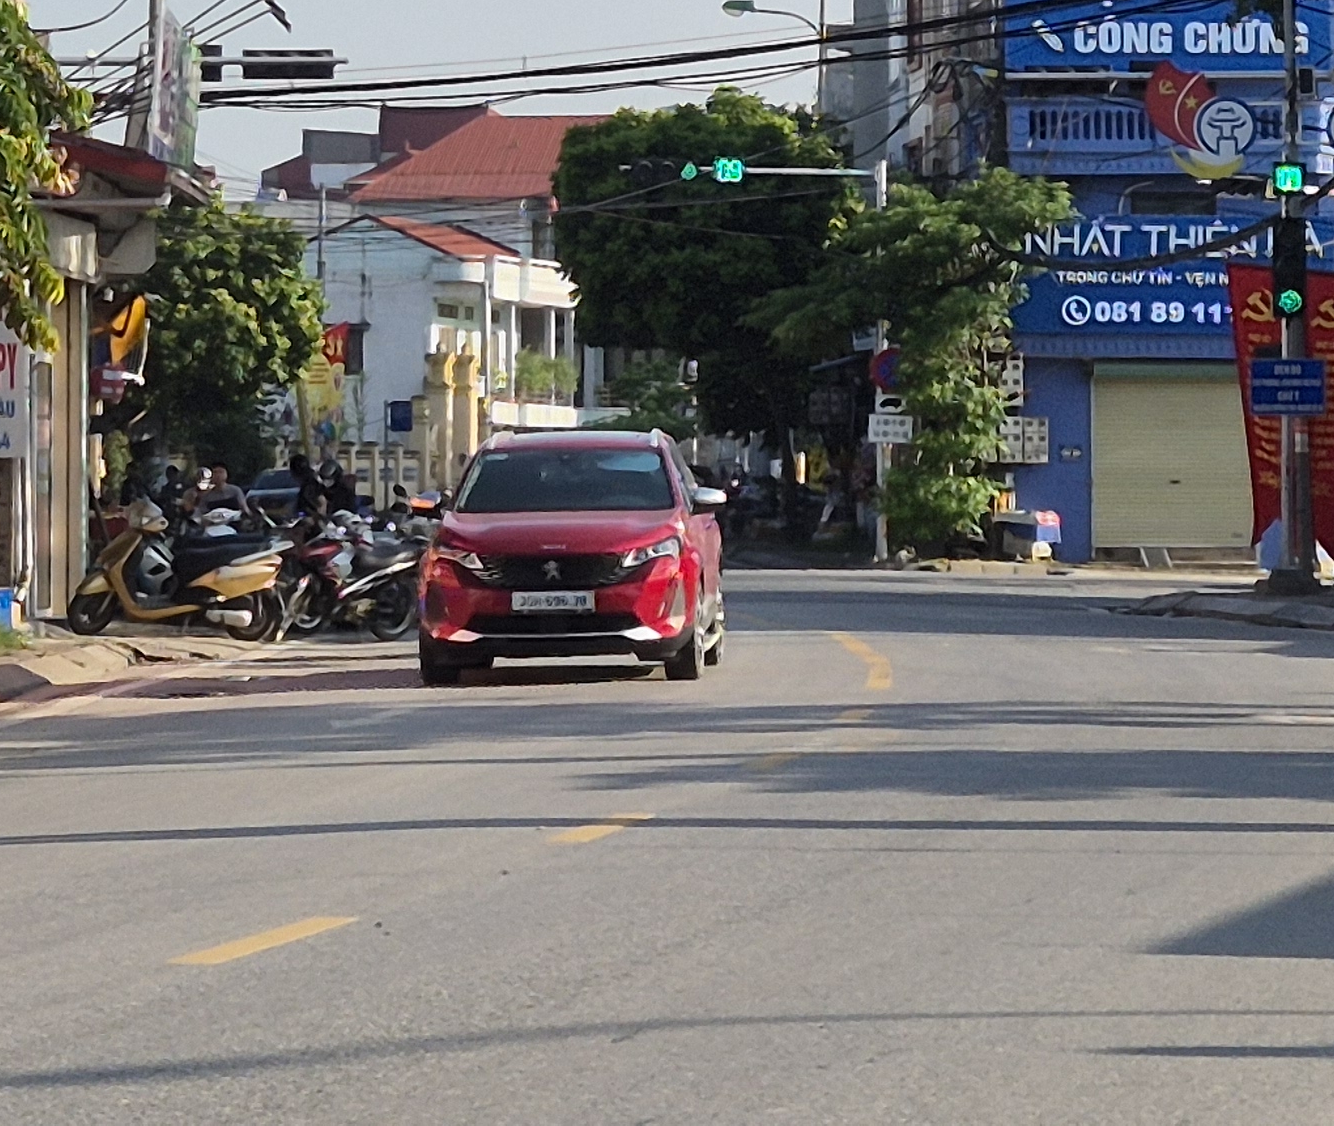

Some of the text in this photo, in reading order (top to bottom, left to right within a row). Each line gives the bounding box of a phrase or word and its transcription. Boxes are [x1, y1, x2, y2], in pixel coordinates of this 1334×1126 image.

[1073, 14, 1173, 54] CÔNG
[1094, 301, 1141, 323] 081
[1150, 301, 1185, 323] 89
